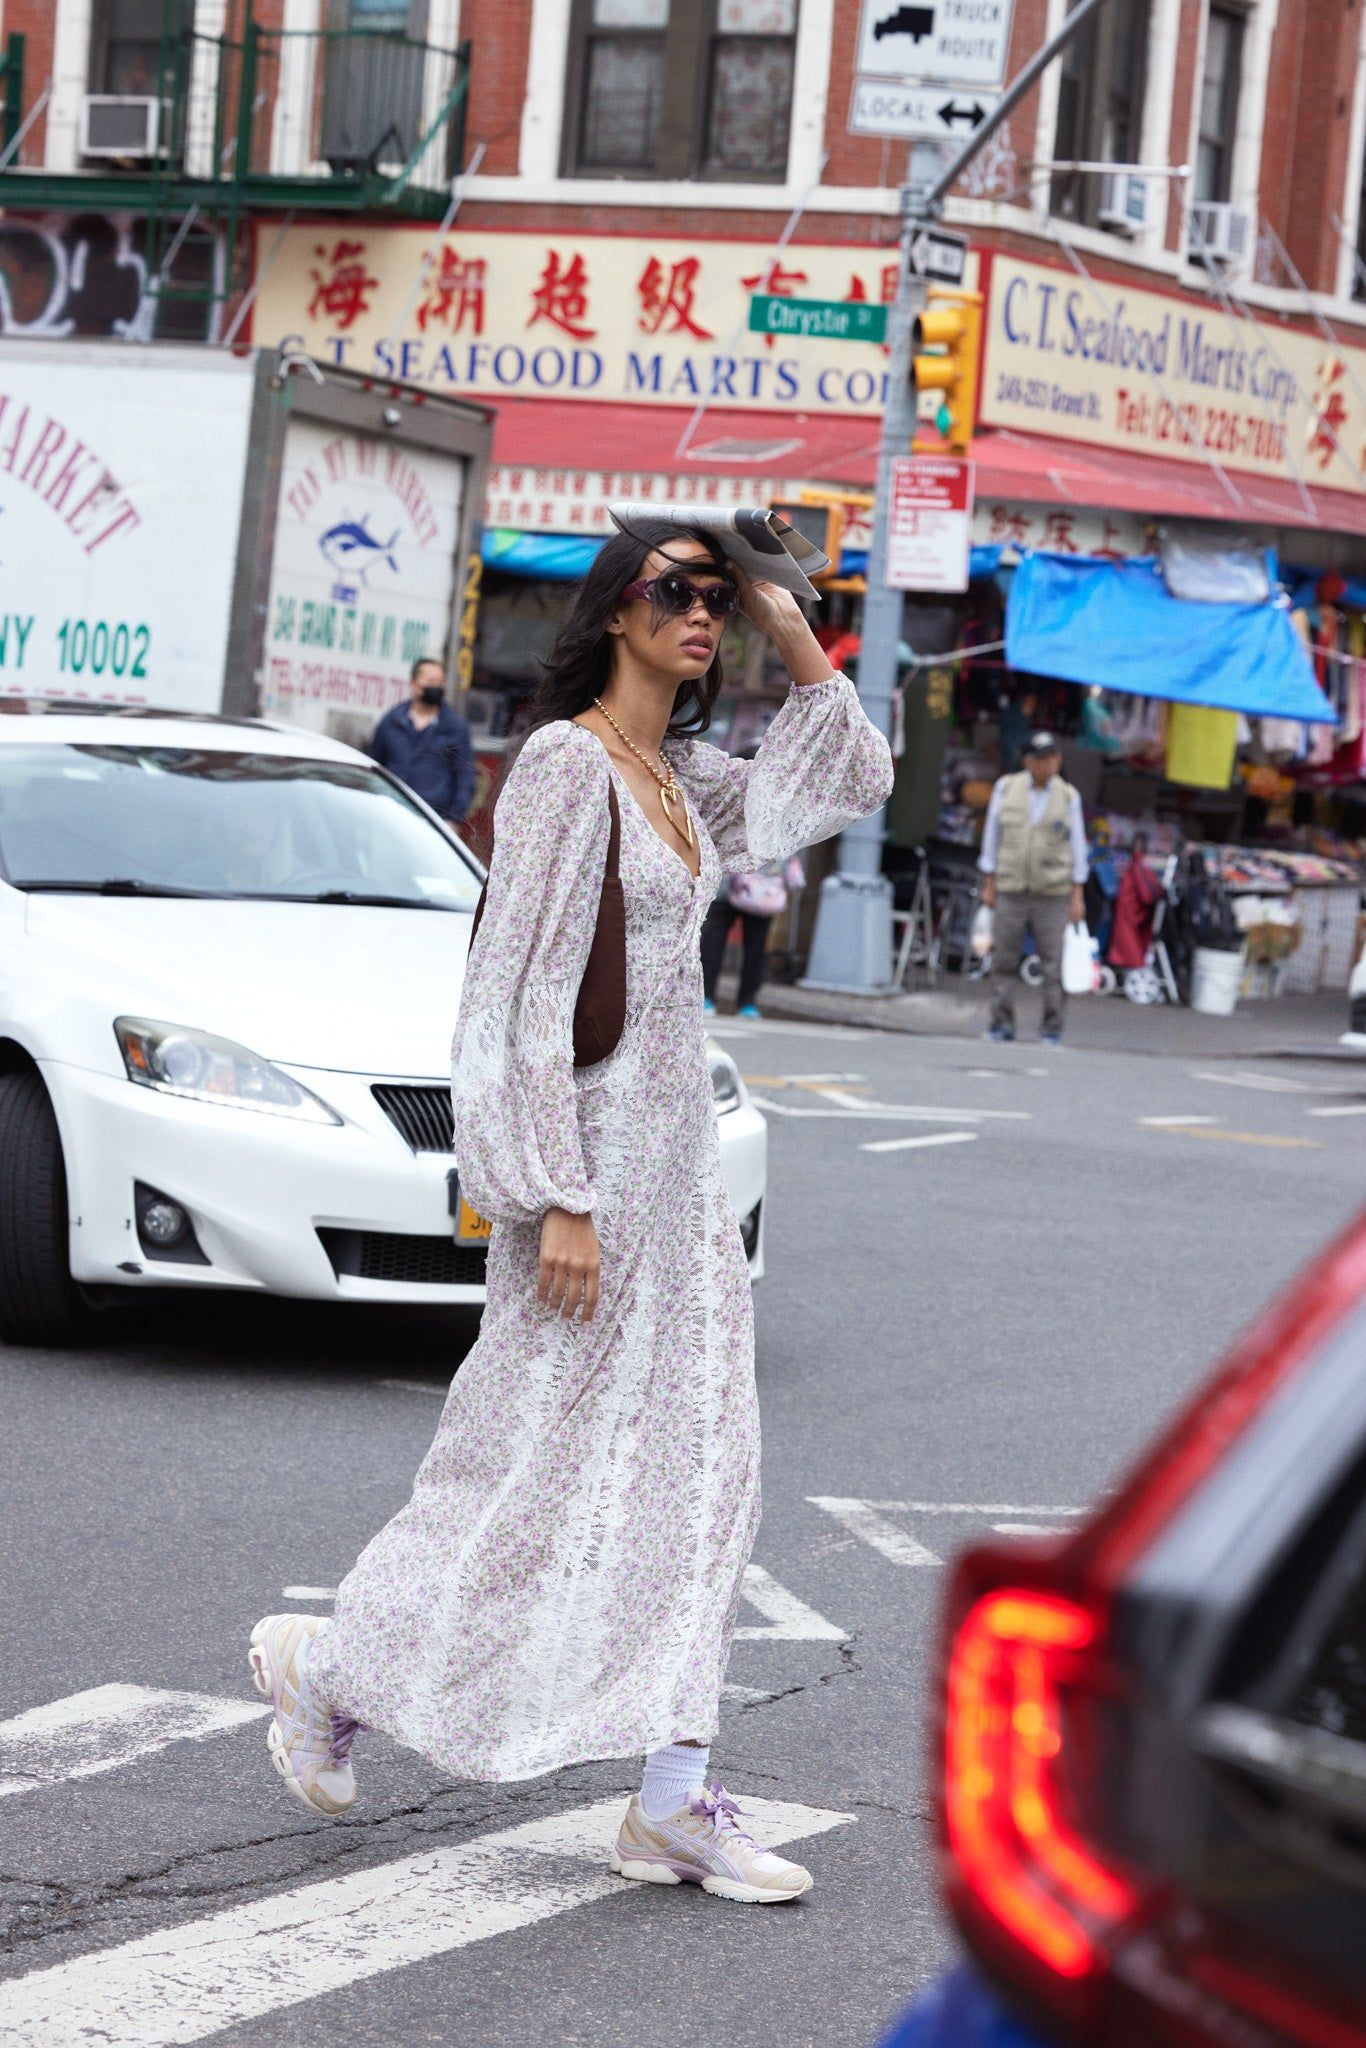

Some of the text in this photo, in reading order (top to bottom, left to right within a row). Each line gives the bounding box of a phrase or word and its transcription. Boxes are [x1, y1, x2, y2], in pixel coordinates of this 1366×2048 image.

[945, 0, 1001, 22] TRUCK
[937, 35, 997, 60] ROUTE
[857, 93, 927, 122] LOCAL
[1062, 289, 1172, 376] Seafood
[1173, 316, 1246, 393] Marts
[373, 338, 603, 388] SEAFOOD
[625, 352, 799, 401] MARTS
[57, 618, 151, 678] 10002
